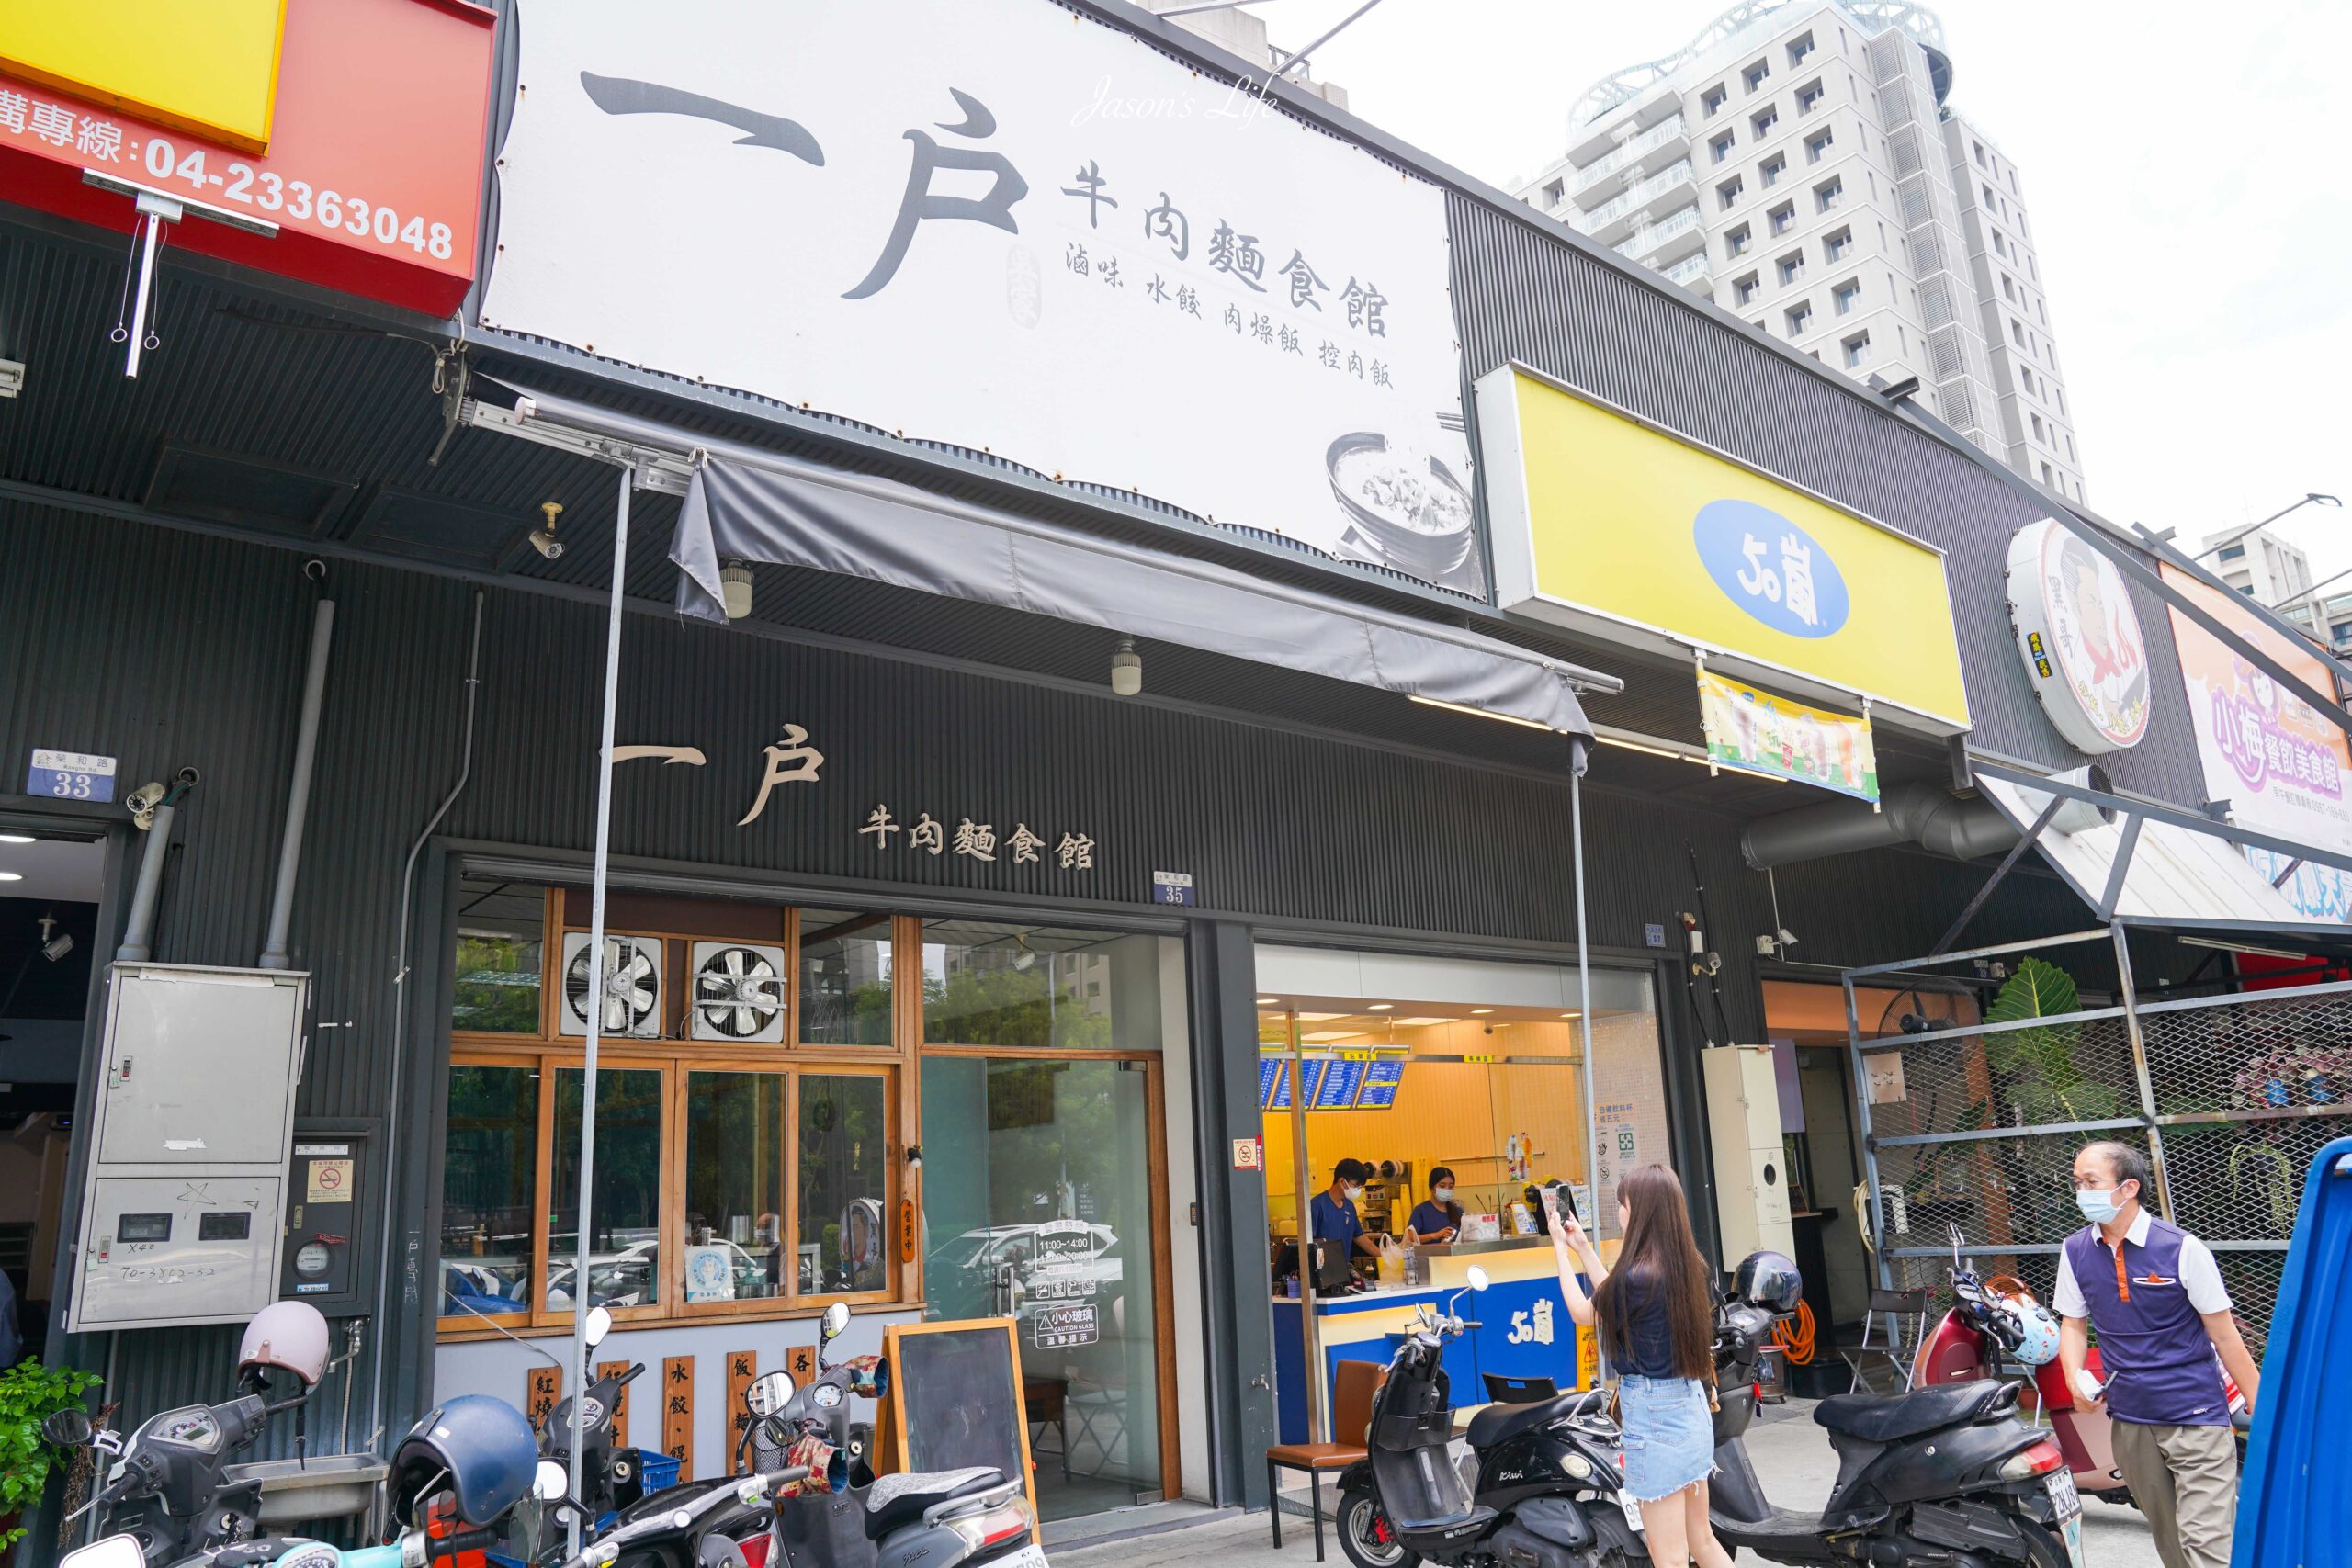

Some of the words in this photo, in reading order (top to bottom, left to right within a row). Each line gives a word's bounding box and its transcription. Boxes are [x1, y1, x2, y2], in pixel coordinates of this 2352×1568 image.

[580, 71, 1030, 300] 一戶
[1060, 159, 1389, 338] 牛肉麵食館
[1066, 242, 1124, 288] 滷味
[1147, 274, 1202, 320] 水餃
[1224, 303, 1304, 357] 肉燥飯
[53, 773, 91, 798] 33
[599, 724, 825, 826] 一戶
[858, 804, 1096, 870] 牛肉麵食館
[1166, 886, 1183, 903] 35
[904, 1210, 912, 1252] 營業中
[1040, 1238, 1089, 1250] 11:00~14:00
[1052, 1309, 1093, 1325] 小心玻璃
[1499, 1470, 1523, 1481] Kiwi
